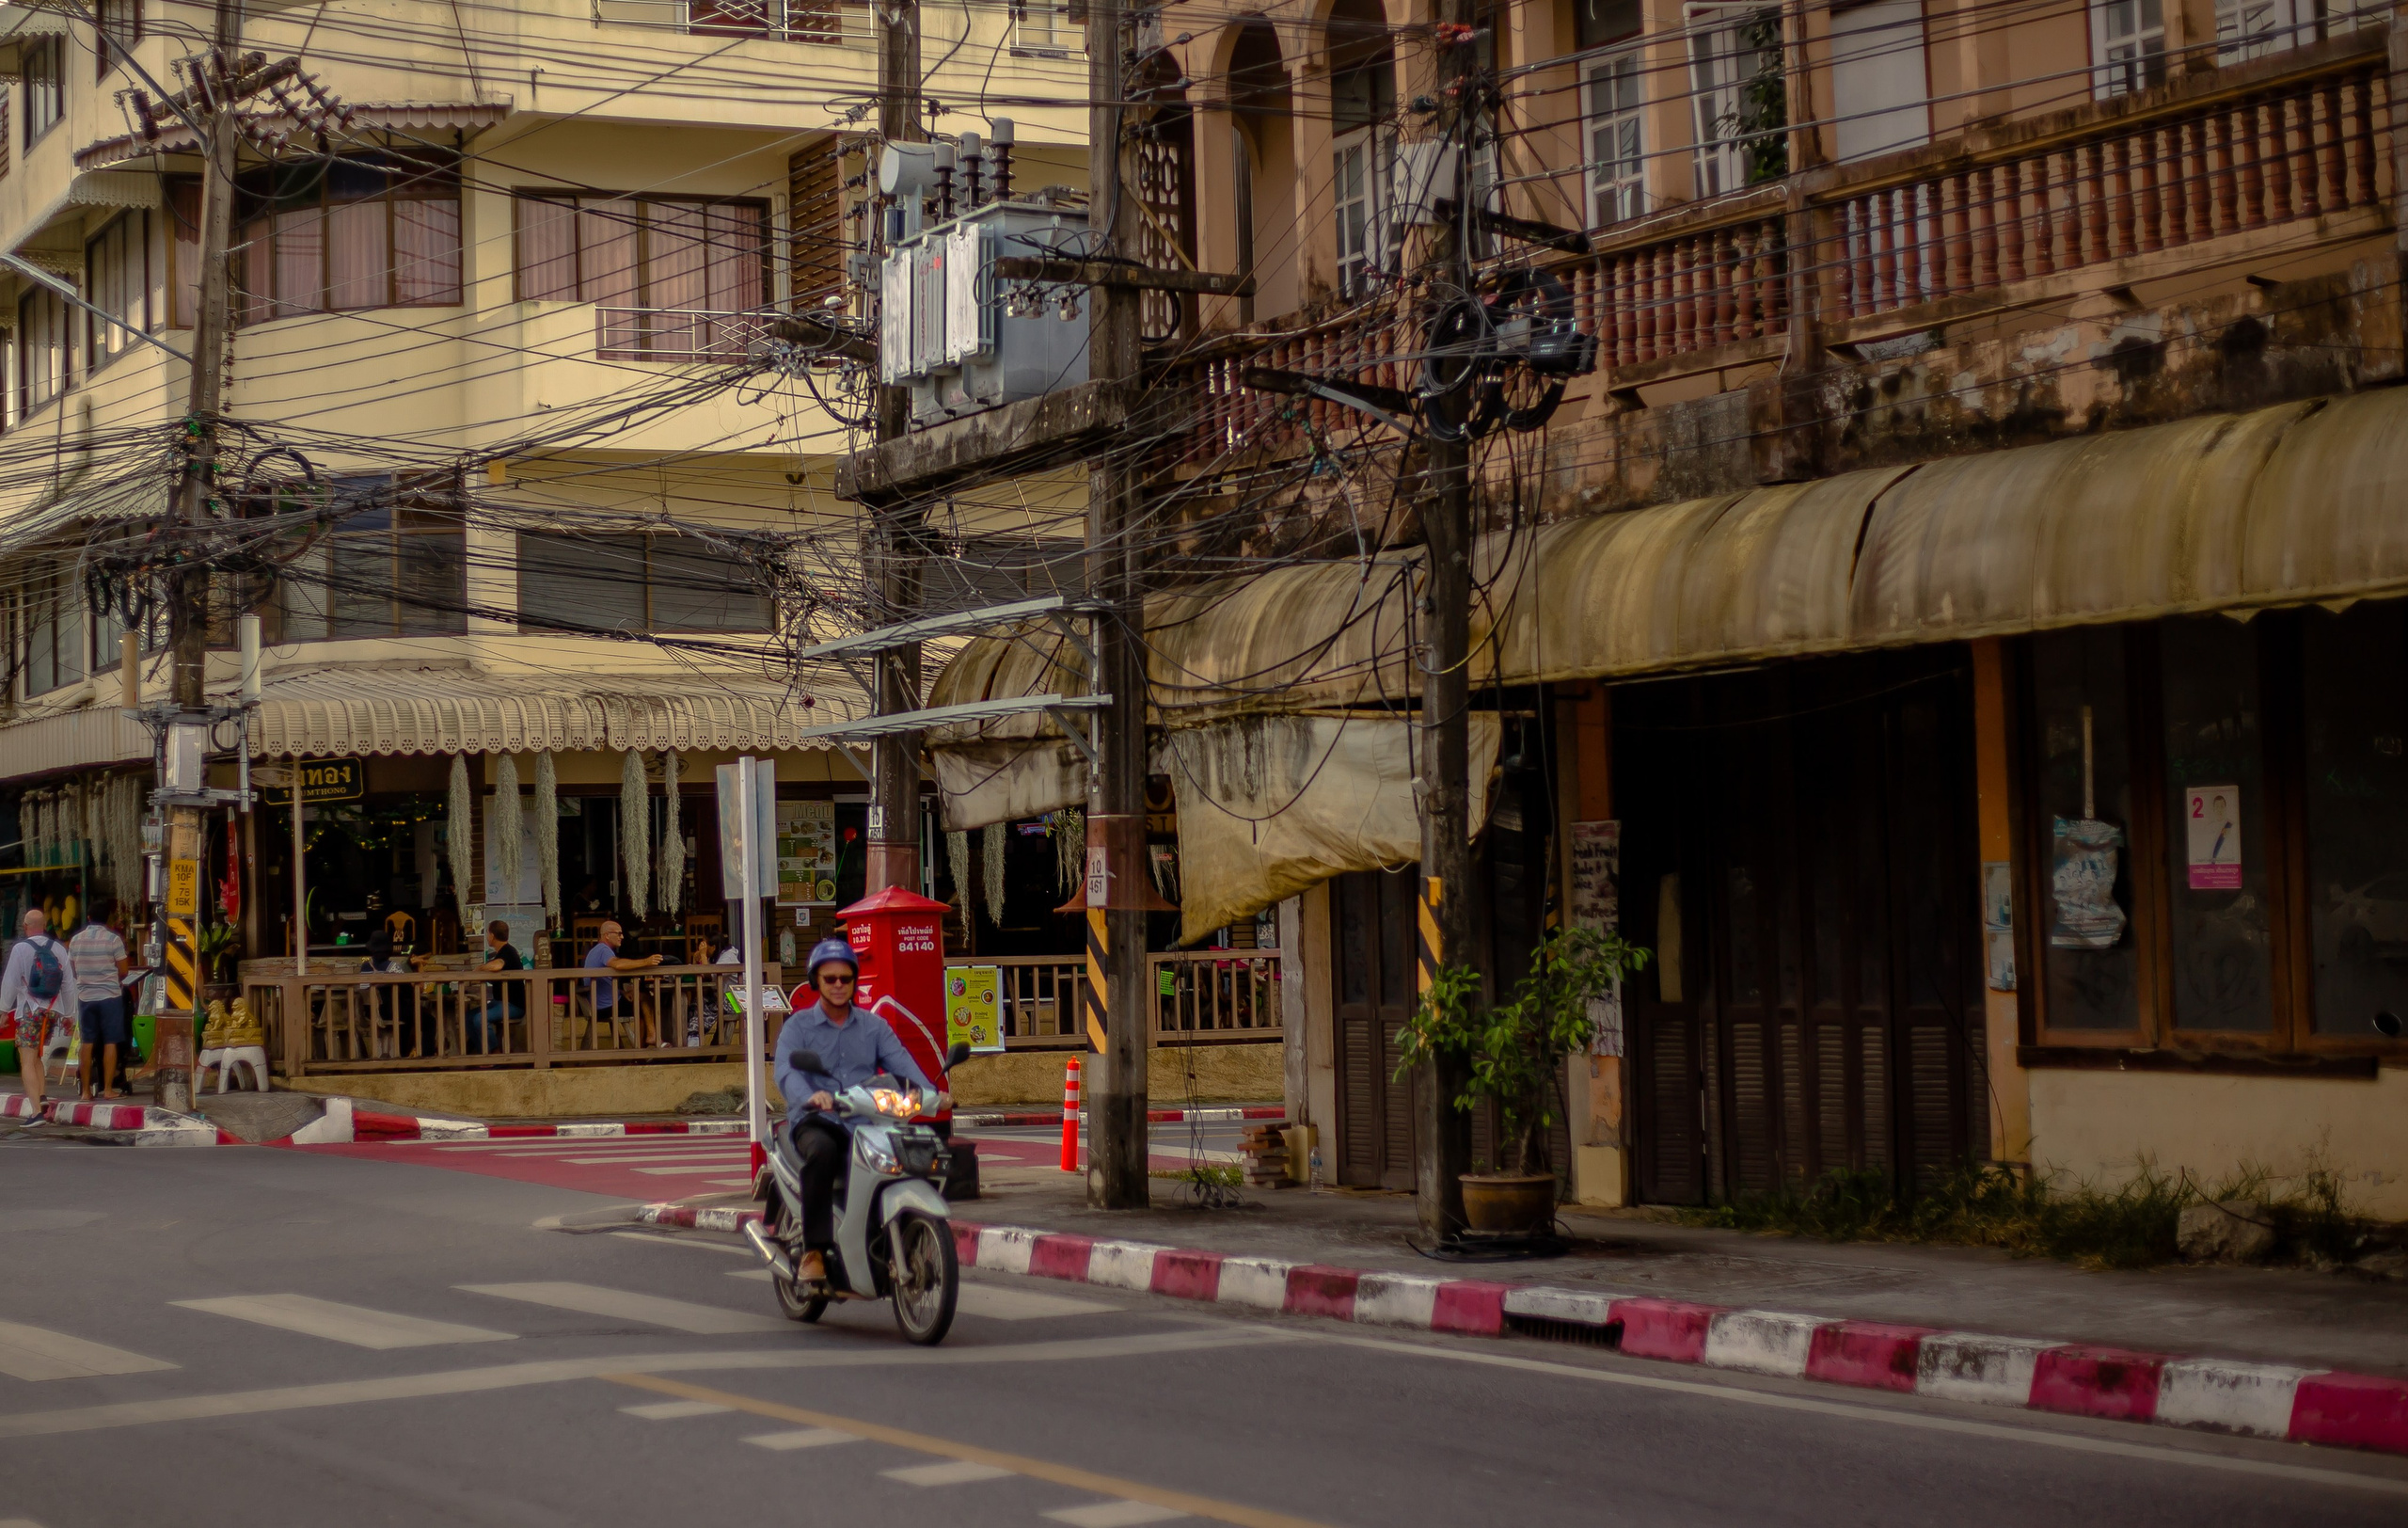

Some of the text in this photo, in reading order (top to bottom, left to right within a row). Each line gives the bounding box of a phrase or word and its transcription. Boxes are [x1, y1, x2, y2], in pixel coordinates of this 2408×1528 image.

[293, 787, 347, 798] UMTHONG
[794, 803, 832, 820] Menu
[2192, 797, 2204, 819] 2
[175, 864, 195, 873] KMA
[1091, 859, 1101, 874] 10
[176, 872, 192, 882] 10F
[1088, 879, 1102, 894] 461
[174, 898, 191, 907] 15K
[897, 925, 933, 935] รหัสไปรษณีย์
[898, 941, 934, 952] 84140
